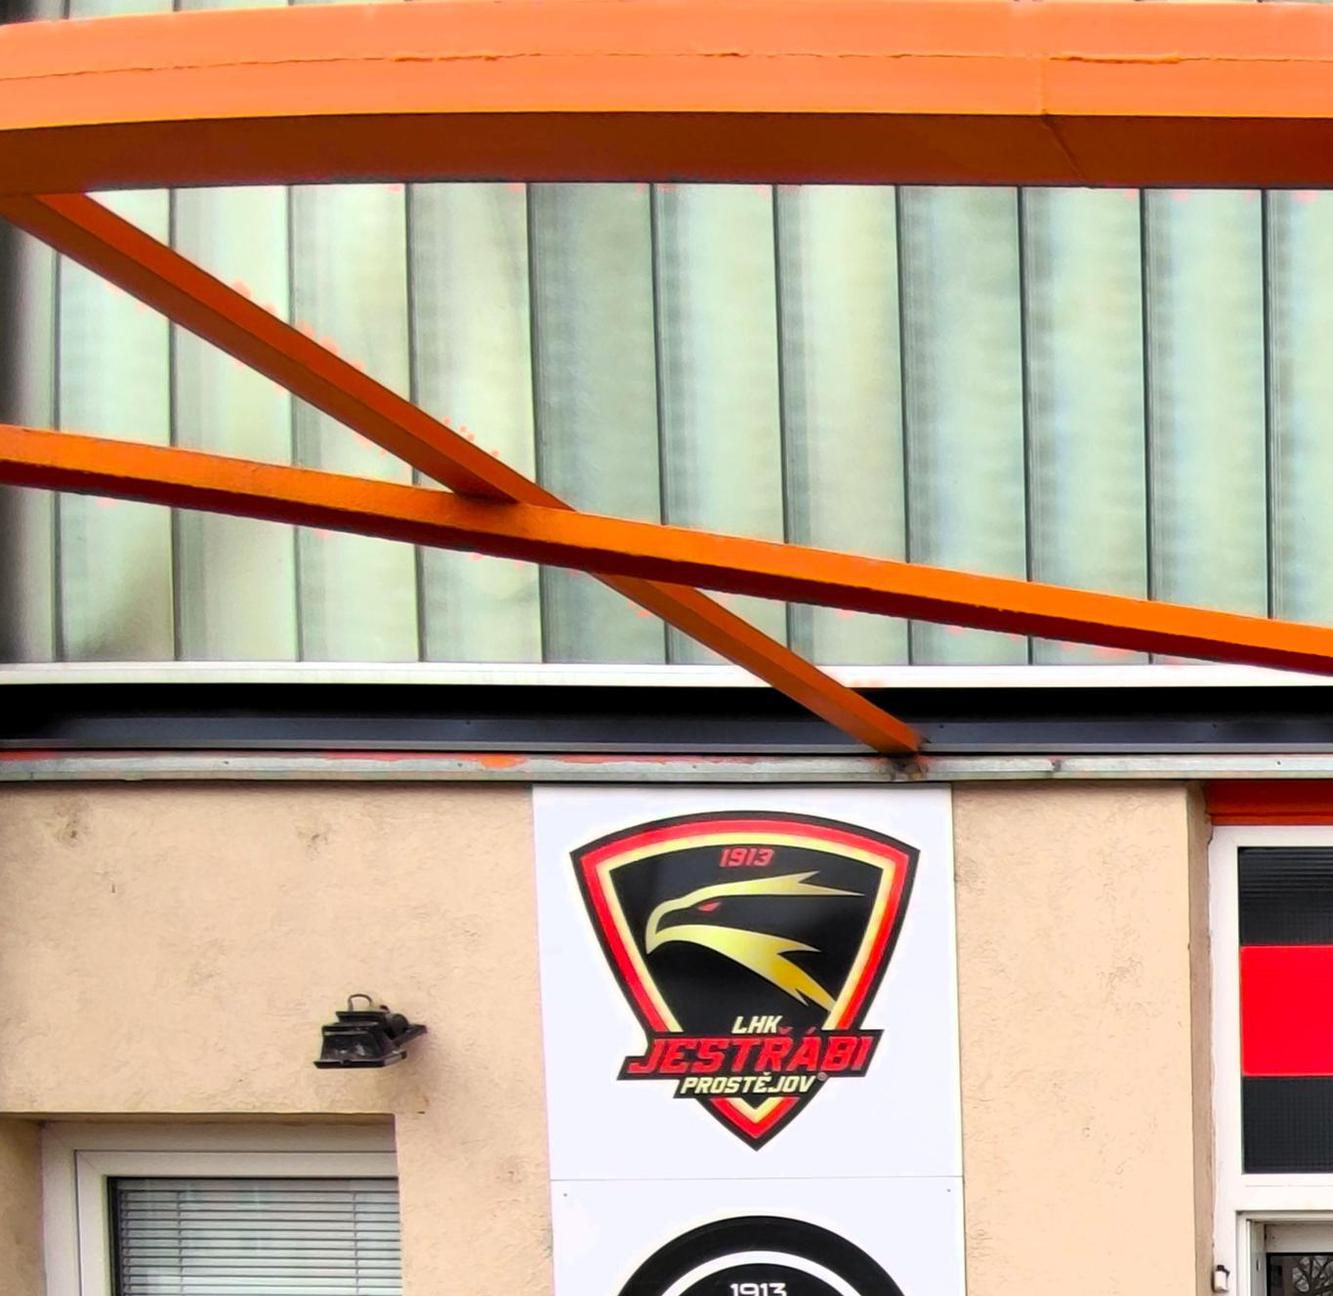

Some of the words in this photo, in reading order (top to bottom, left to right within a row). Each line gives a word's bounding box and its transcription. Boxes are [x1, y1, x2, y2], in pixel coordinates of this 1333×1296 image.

[719, 847, 774, 867] 1913
[731, 1015, 783, 1034] LHK
[627, 1026, 874, 1074] JESTŘÁBI
[680, 1072, 816, 1094] PROSTĚJOV
